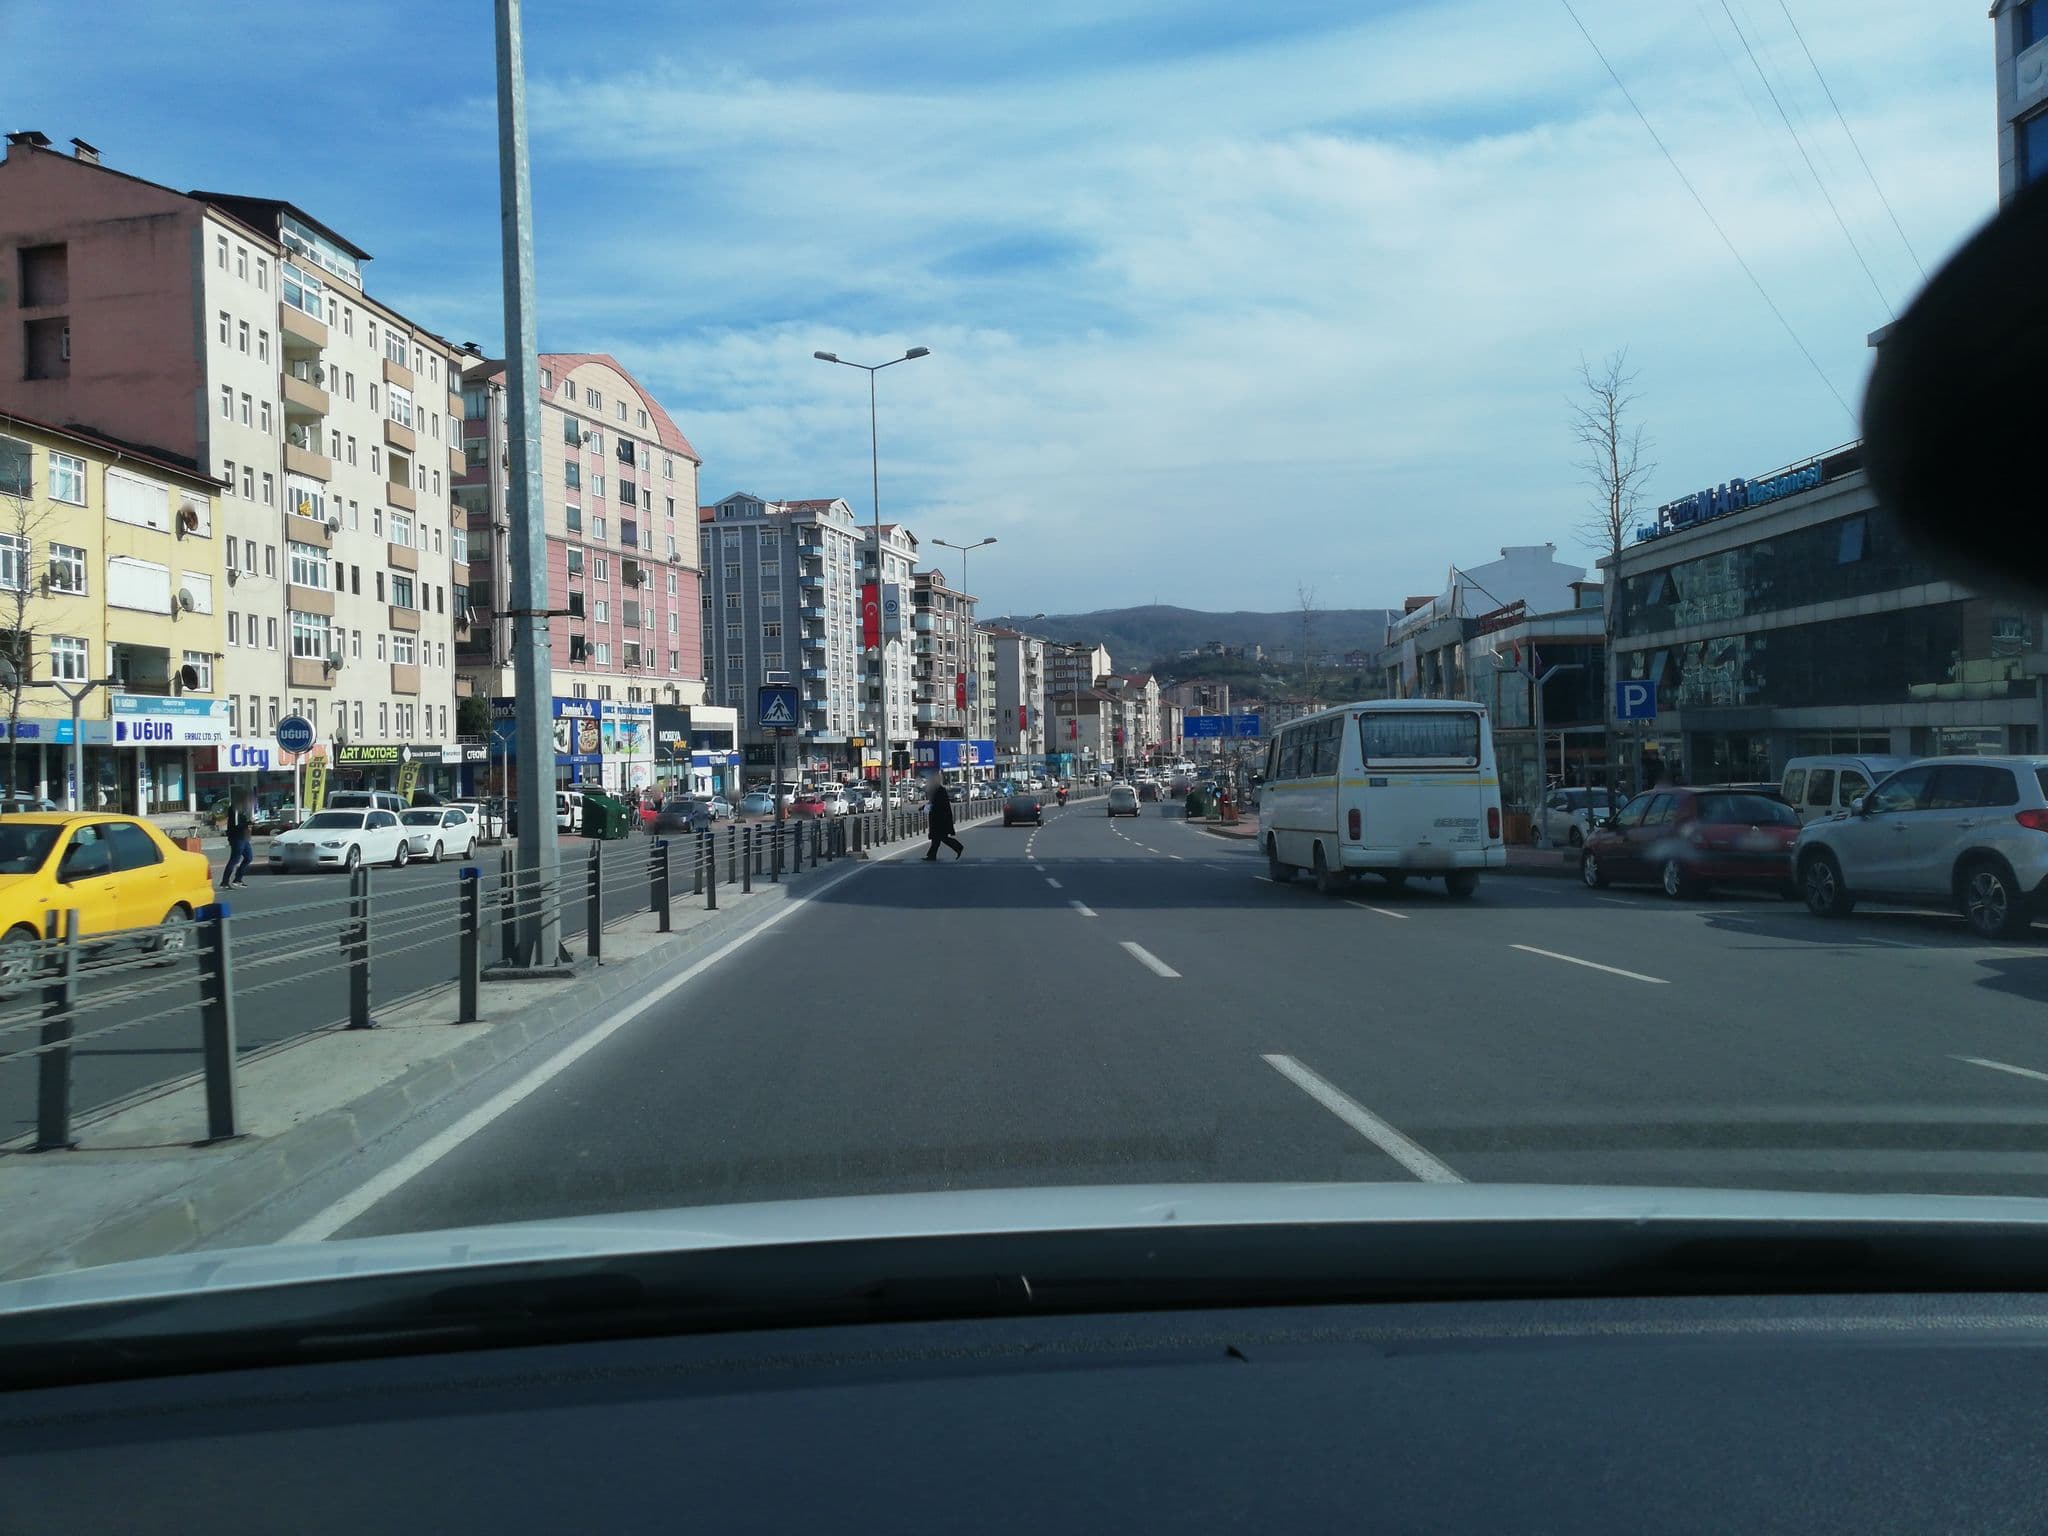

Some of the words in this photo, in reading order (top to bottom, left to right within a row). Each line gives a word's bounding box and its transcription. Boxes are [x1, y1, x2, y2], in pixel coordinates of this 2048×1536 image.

[1624, 684, 1648, 716] P
[133, 719, 173, 741] UĞUR
[280, 729, 310, 740] UĞUR
[230, 743, 270, 773] City
[339, 747, 359, 760] ART
[361, 747, 398, 760] MOTORS
